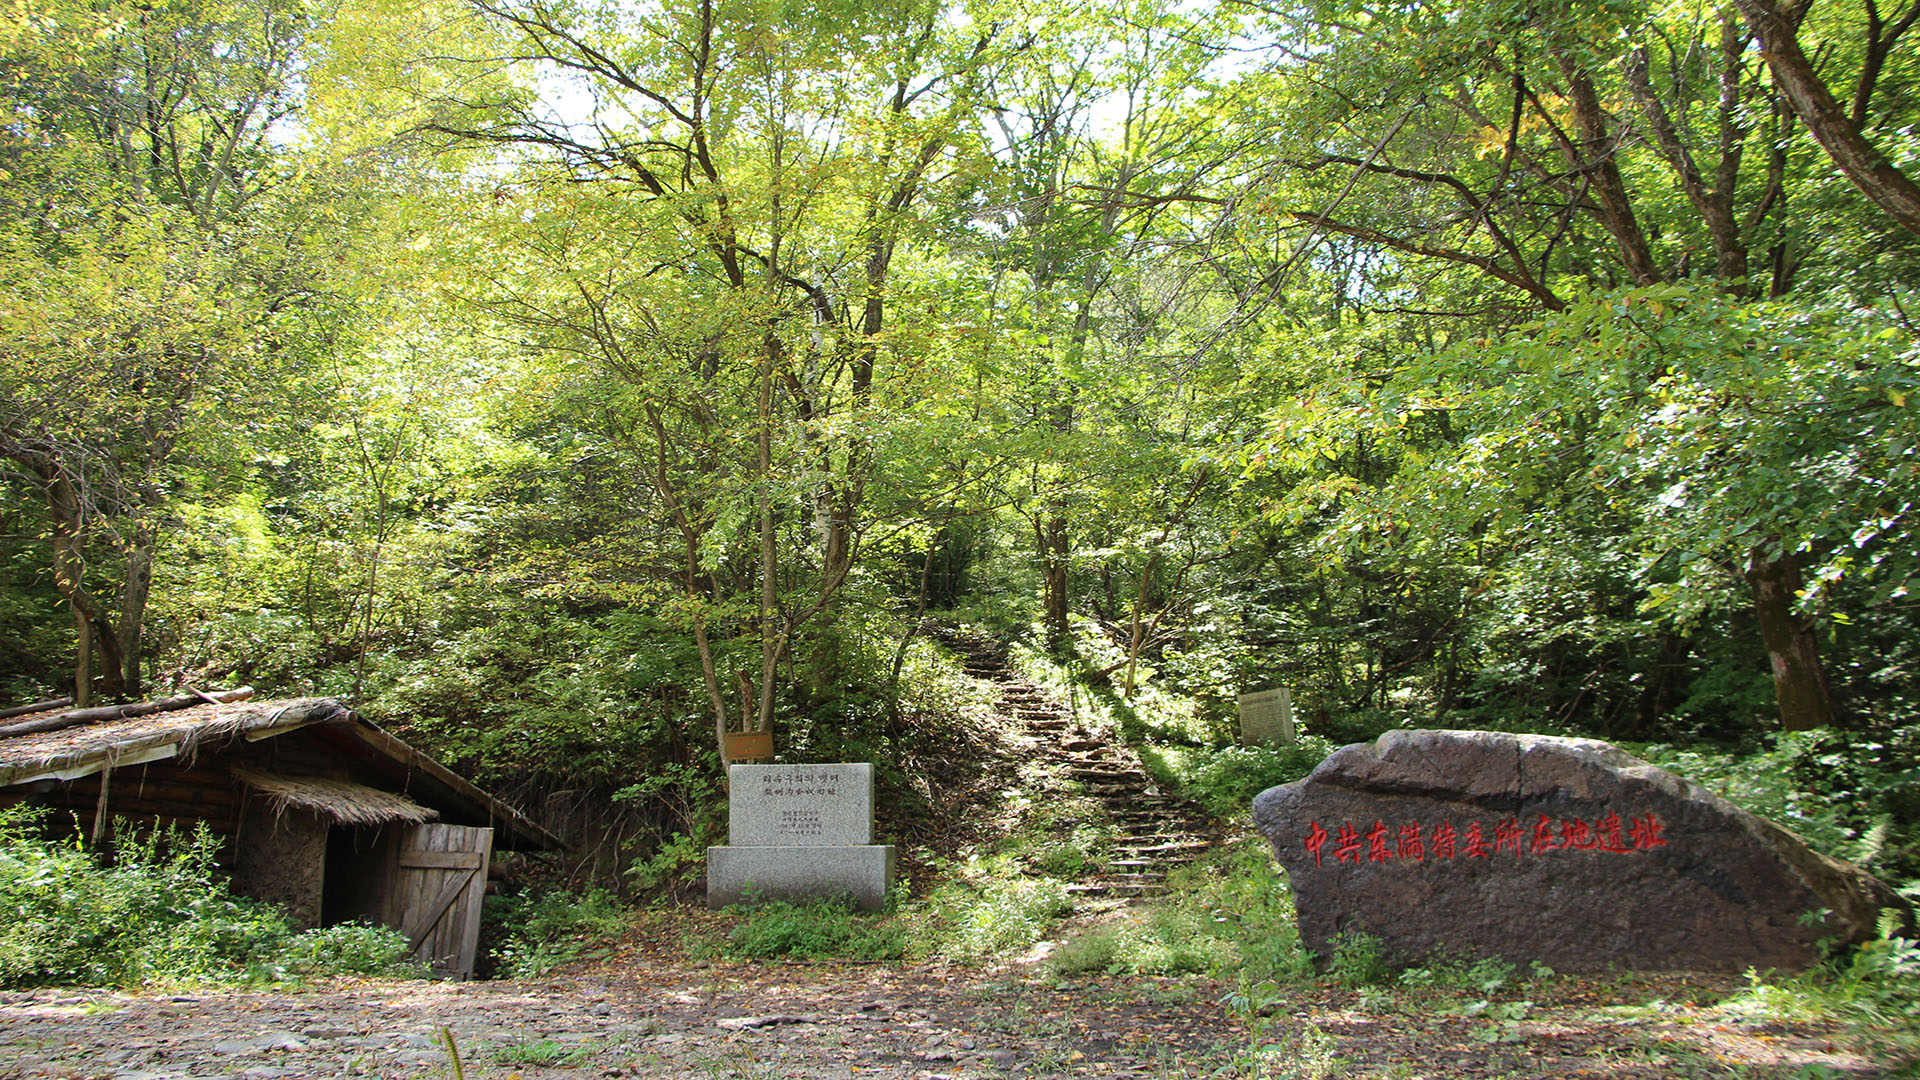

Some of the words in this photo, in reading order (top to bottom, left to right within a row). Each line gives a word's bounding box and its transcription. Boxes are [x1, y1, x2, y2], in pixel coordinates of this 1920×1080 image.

[1303, 811, 1668, 868] 中共东满特委所在地遗址
